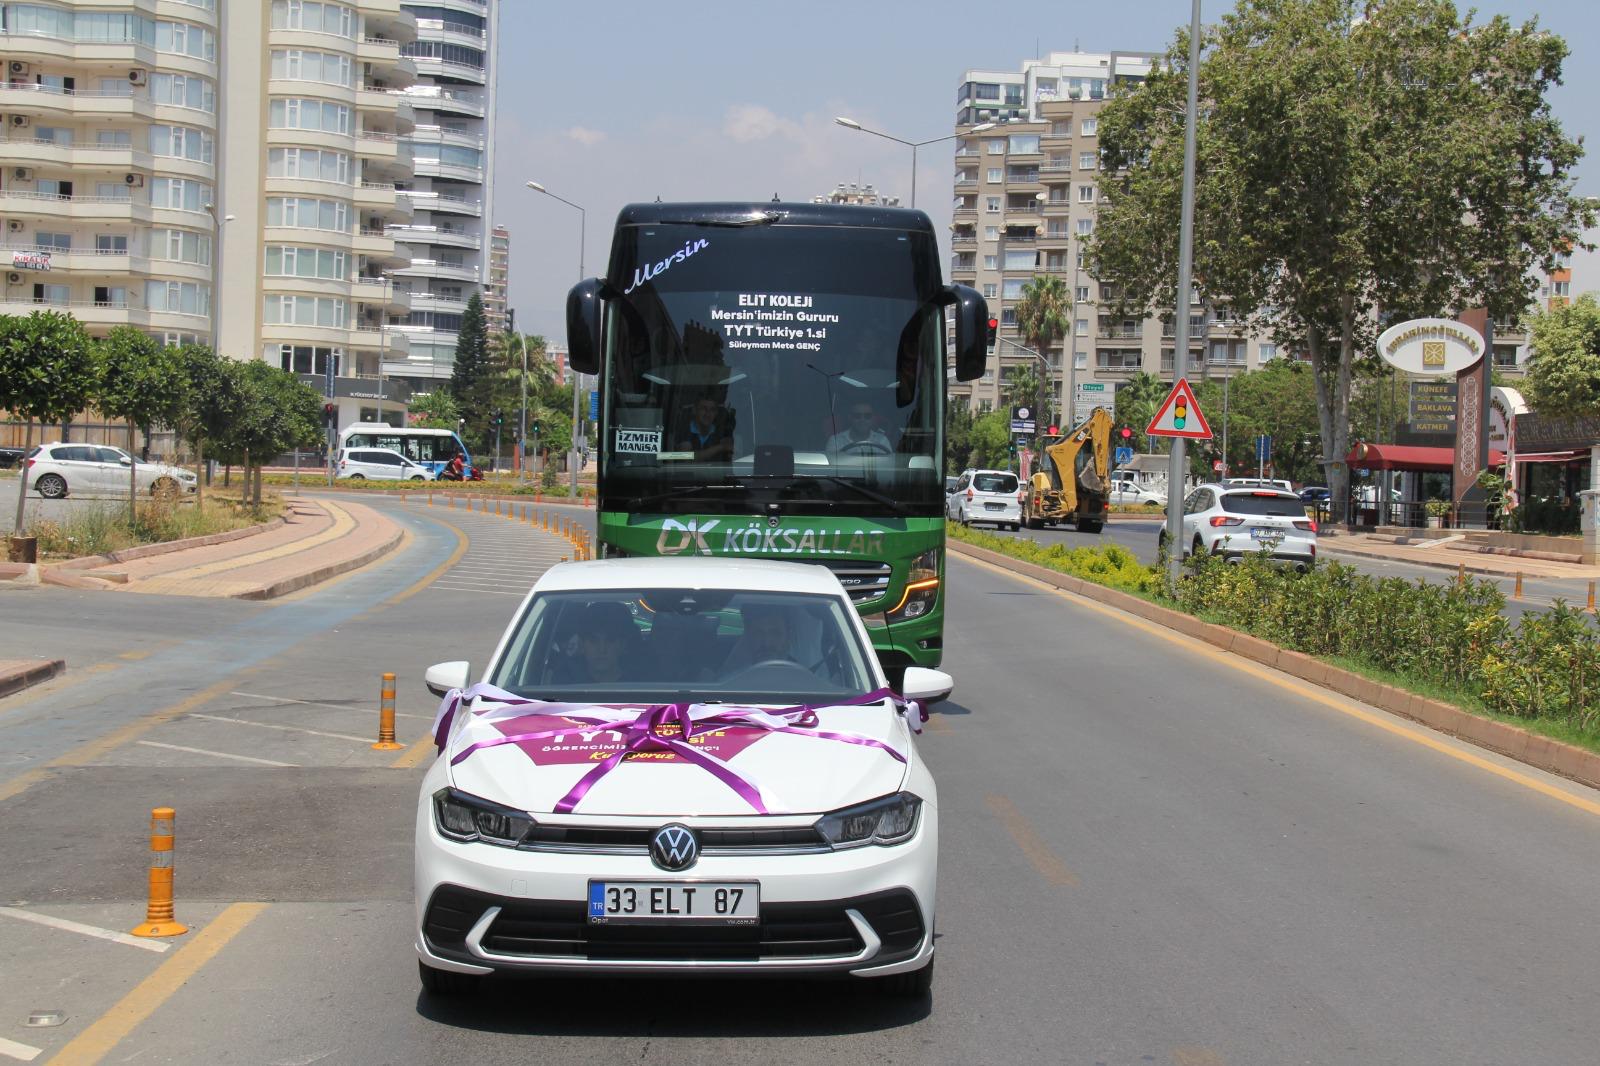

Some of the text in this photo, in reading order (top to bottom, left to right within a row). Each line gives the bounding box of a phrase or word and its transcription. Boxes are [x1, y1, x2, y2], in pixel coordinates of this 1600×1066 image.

[624, 239, 709, 294] Mersin
[796, 311, 839, 323] Gururu
[724, 324, 826, 339] TYT Türkiye 1.si
[728, 341, 821, 351] Süleyman Mete GENÇ
[1418, 384, 1449, 393] KÜNEFE
[1417, 403, 1453, 412] BAKLAVA
[1416, 423, 1449, 431] KATMER
[723, 522, 886, 555] KÖKSALLAR
[593, 887, 744, 914] TR 33 ELT 87
